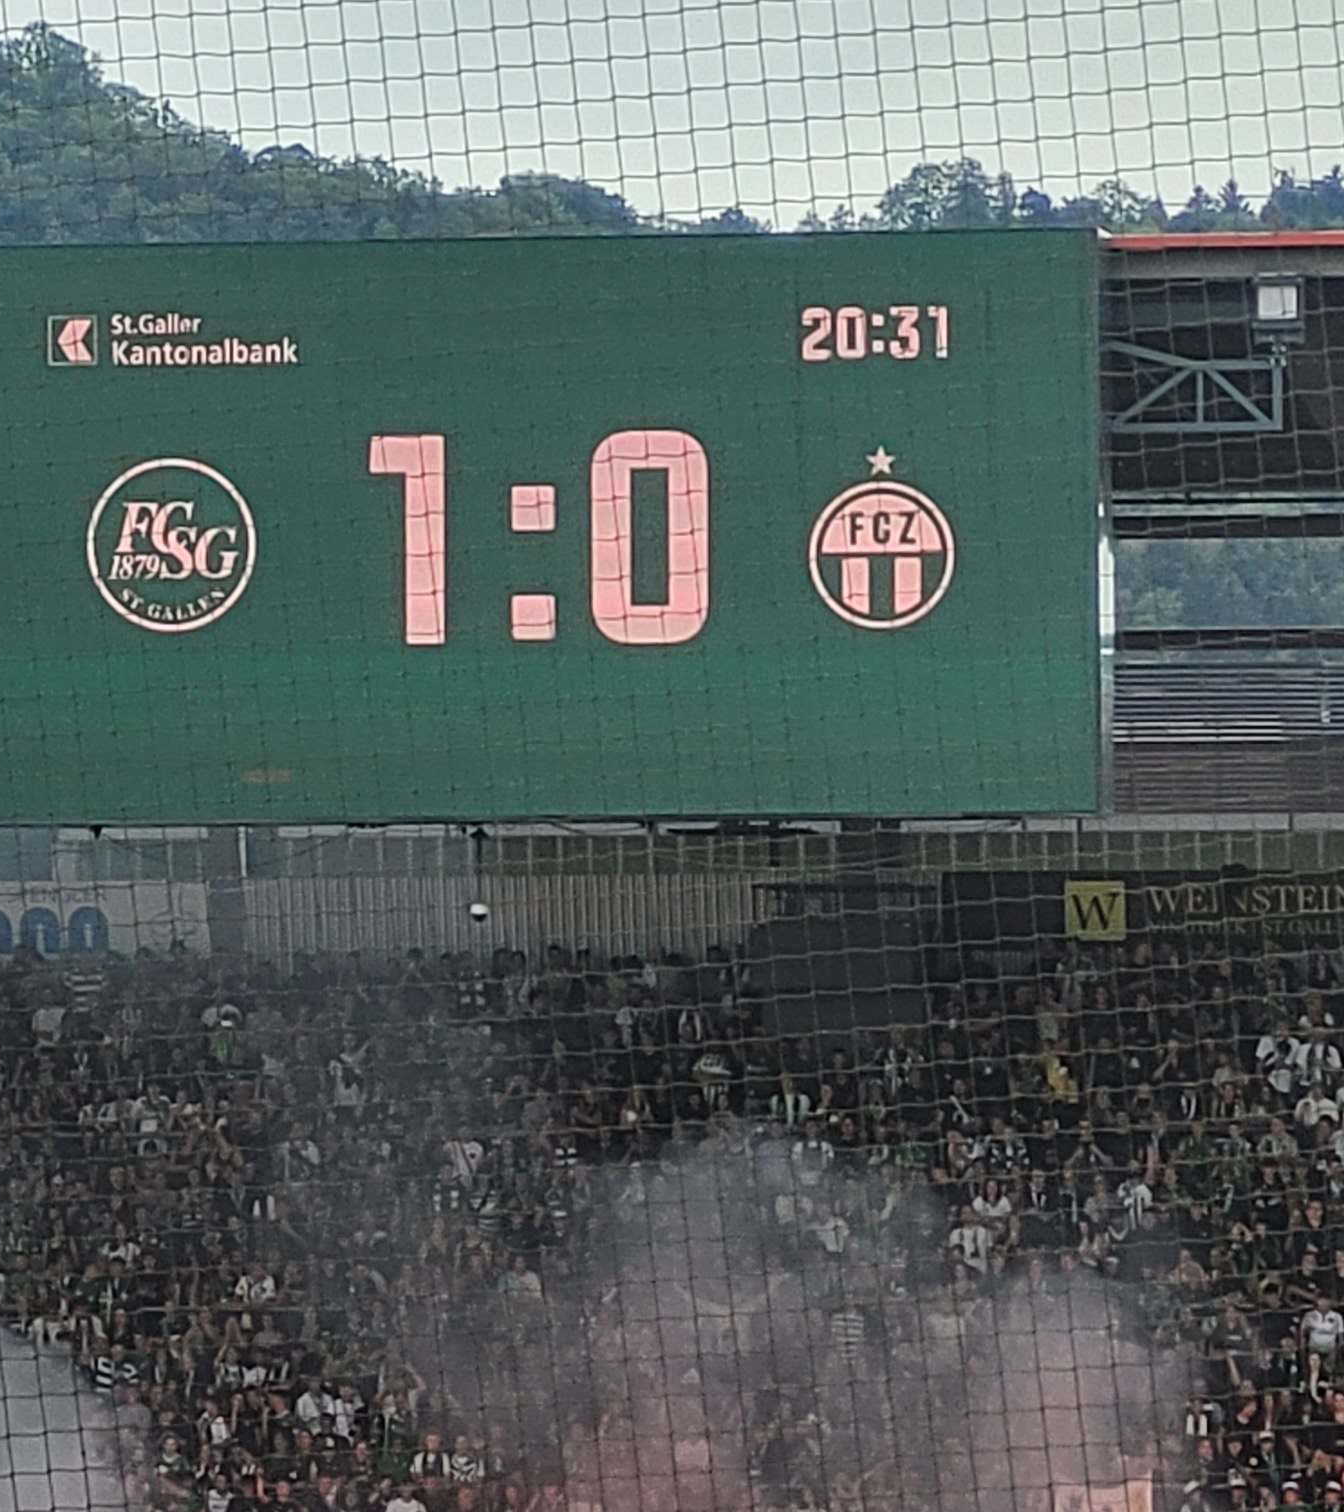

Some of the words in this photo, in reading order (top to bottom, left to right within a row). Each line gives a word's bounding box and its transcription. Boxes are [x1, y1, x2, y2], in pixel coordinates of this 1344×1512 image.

[111, 336, 298, 366] Kantonalbank
[801, 306, 948, 361] 20:31
[849, 511, 916, 546] FCZ
[108, 553, 161, 581] 1879
[1071, 889, 1120, 931] W
